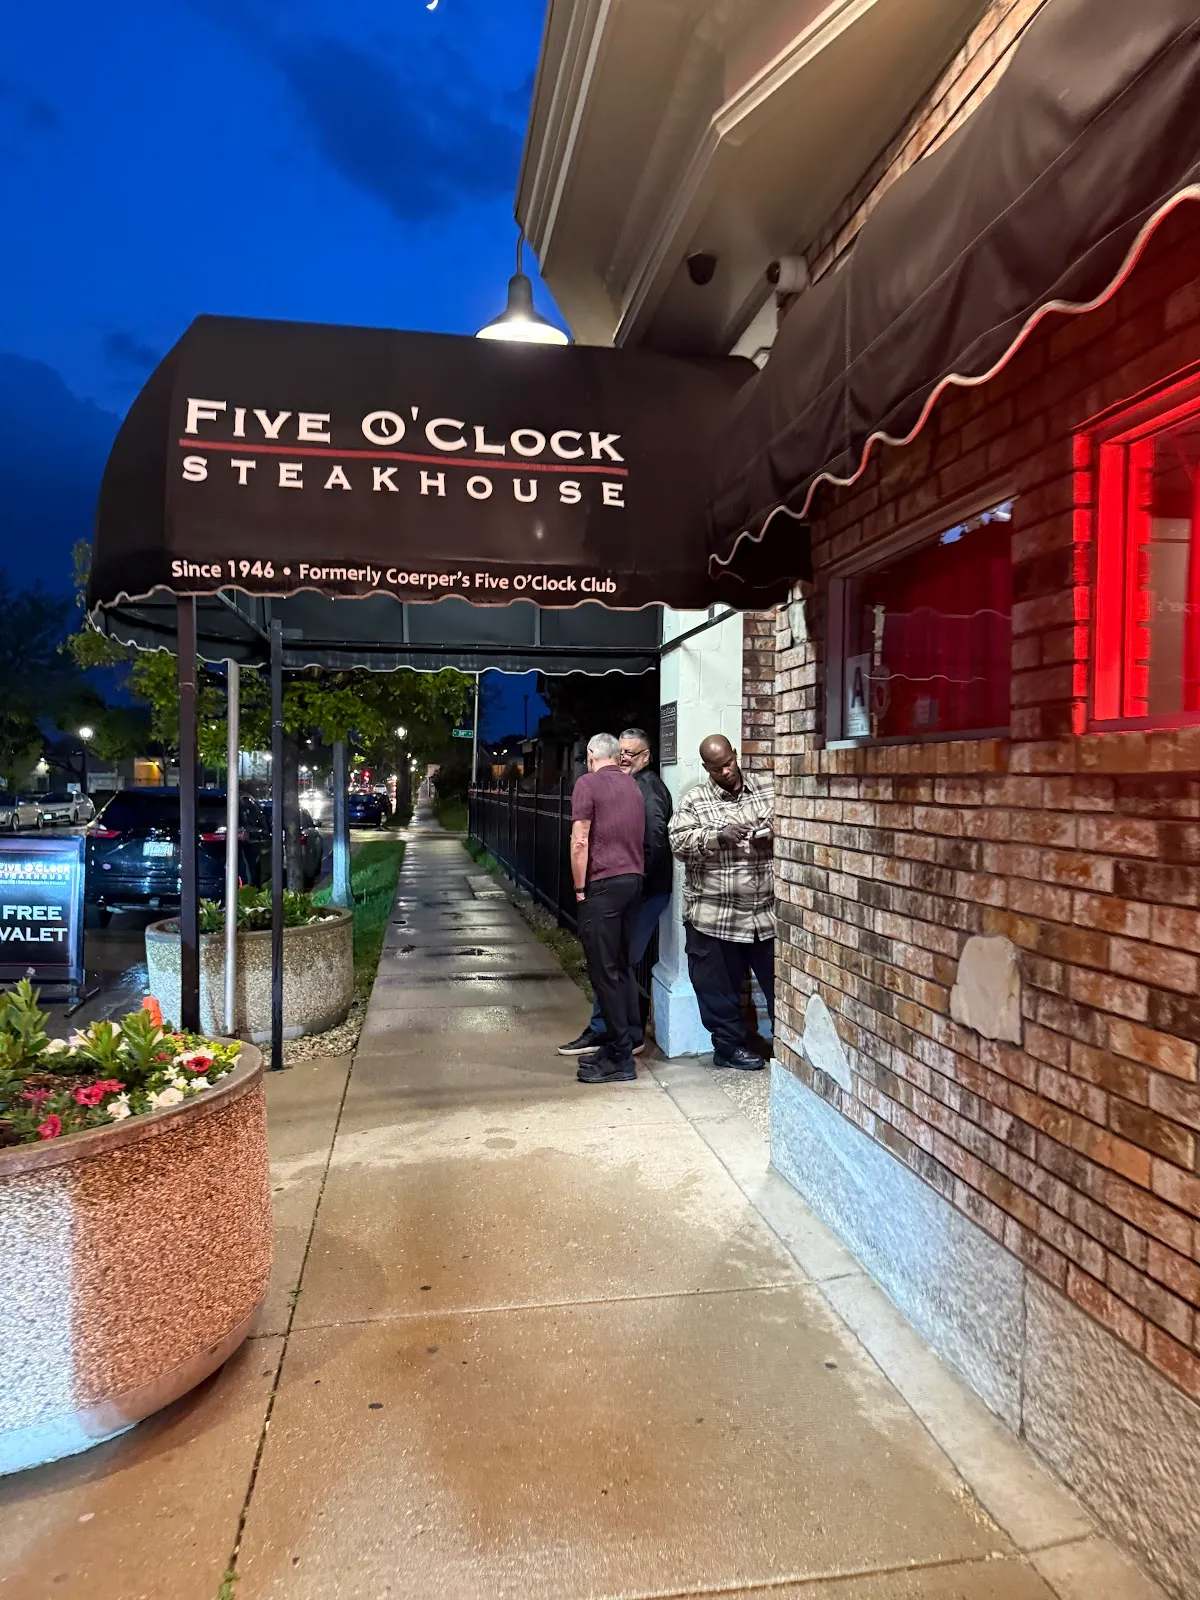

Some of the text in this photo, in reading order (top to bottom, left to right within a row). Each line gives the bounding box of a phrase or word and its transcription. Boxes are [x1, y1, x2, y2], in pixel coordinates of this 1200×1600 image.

[182, 455, 625, 508] STEAKHOUSE
[171, 560, 617, 593] Since 1946 Formerly Coerper's Five O'Clock Club
[3, 905, 63, 921] FREE
[0, 927, 68, 942] VALET
